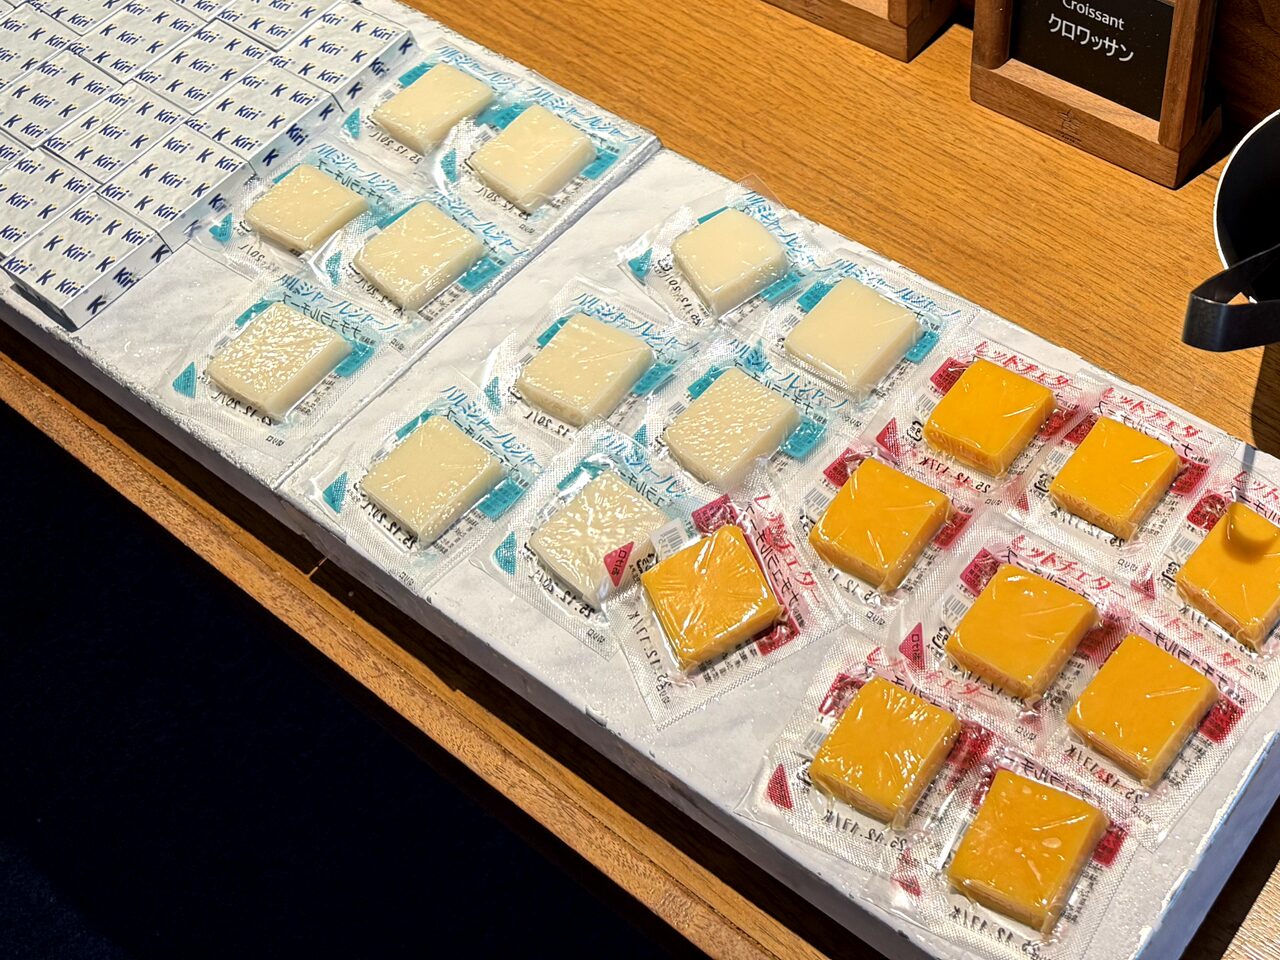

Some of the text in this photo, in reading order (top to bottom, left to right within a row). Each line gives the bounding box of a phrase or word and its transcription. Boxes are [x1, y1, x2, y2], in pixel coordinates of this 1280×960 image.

[123, 3, 148, 15] Kiri
[269, 0, 294, 11] Kiri
[68, 15, 93, 28] Kiri
[218, 9, 243, 22] Kiri
[1, 18, 24, 31] Kiri
[266, 25, 292, 38] Kiri
[45, 34, 70, 48] Kiri
[116, 31, 142, 44] Kiri
[370, 28, 395, 40] Kiri
[1048, 13, 1134, 62] クロワッサン
[242, 46, 268, 59] Kiri
[37, 61, 63, 76] Kiri
[110, 59, 136, 73] Kiri
[240, 75, 265, 88] Kiri
[317, 72, 343, 84] Kiri
[184, 87, 210, 100] Kiri
[289, 91, 315, 104] Kiri
[29, 94, 56, 108] Kiri
[234, 105, 262, 120] Kiri
[21, 123, 47, 138] Kiri
[286, 123, 308, 146] Kiri
[43, 135, 70, 150] Kiri
[231, 136, 258, 150] Kiri
[93, 155, 120, 170] Kiri
[215, 156, 242, 171] Kiri
[63, 178, 91, 193] Kiri
[159, 172, 186, 187] Kiri
[6, 192, 34, 209] Kiri
[153, 205, 181, 221] Kiri
[122, 228, 150, 245] Kiri
[63, 244, 91, 261] Kiri
[55, 279, 84, 297] Kiri
